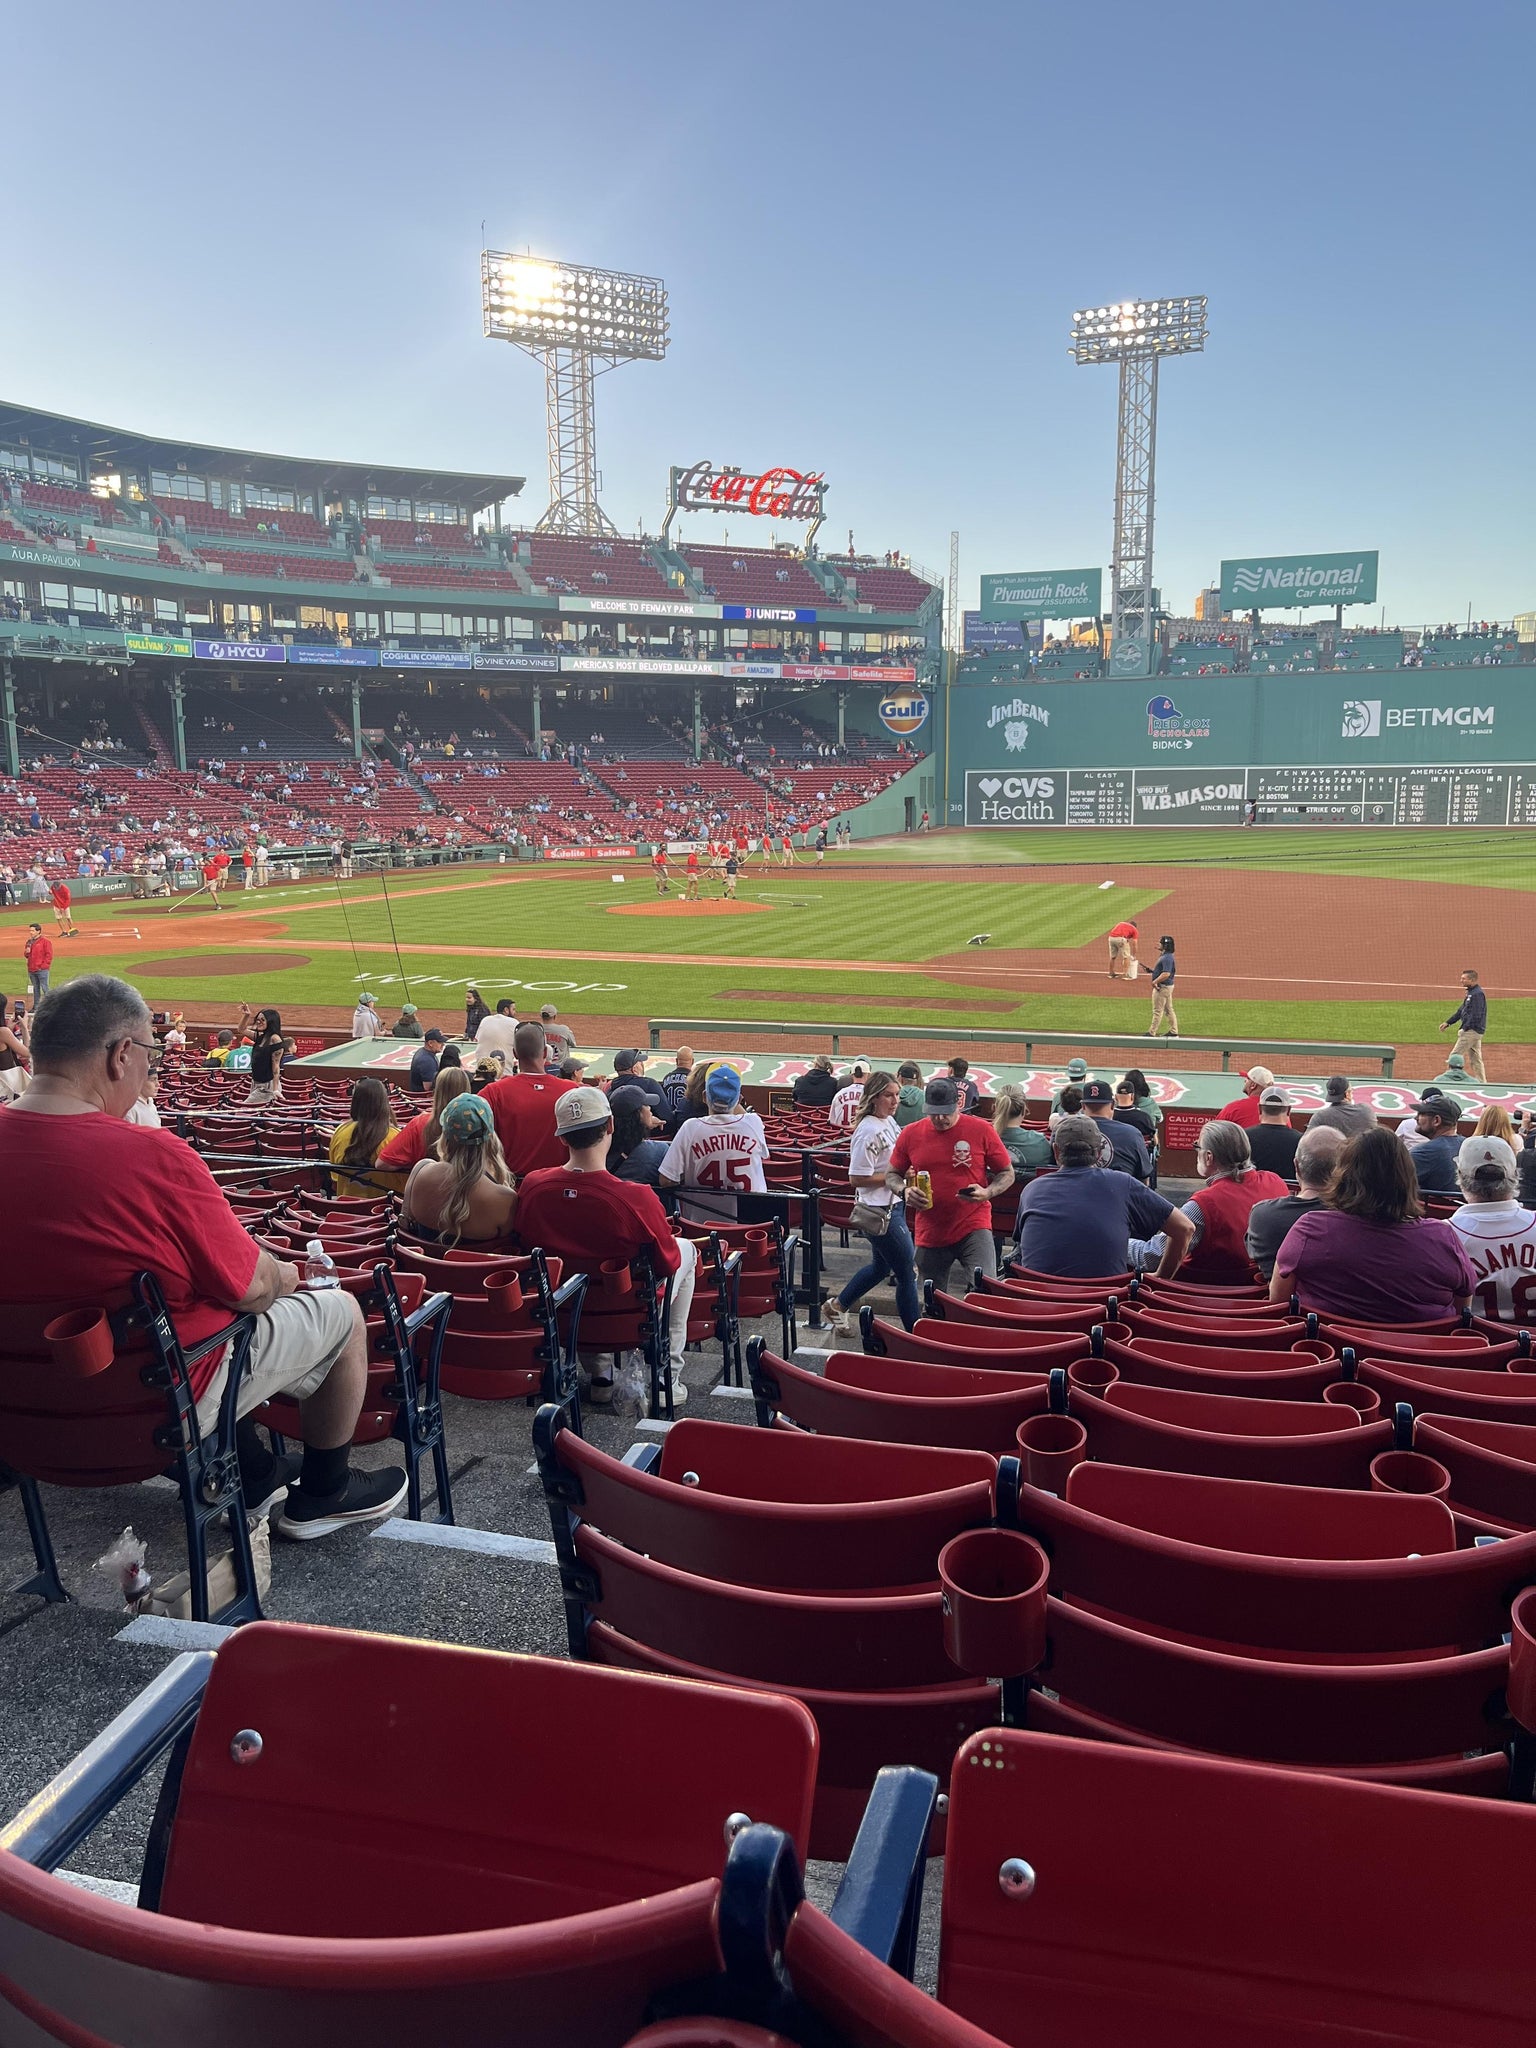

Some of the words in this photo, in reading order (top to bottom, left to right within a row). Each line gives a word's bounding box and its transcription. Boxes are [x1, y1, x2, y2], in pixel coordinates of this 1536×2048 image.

[680, 460, 825, 520] Coca-Cola
[42, 554, 80, 567] PAVILION
[994, 584, 1052, 603] Plymouth
[1055, 582, 1088, 597] Rock
[1296, 589, 1315, 598] Car
[1319, 586, 1357, 597] Rental
[590, 601, 627, 610] WELCOME
[629, 602, 638, 610] TO
[641, 604, 672, 613] FENWAY
[674, 605, 694, 614] PARK
[756, 609, 796, 620] UNITED
[128, 637, 163, 651] SULLIVAN
[174, 644, 189, 653] TIRE
[228, 646, 266, 658] HYCU
[574, 660, 614, 670] AMERICA'S
[617, 662, 636, 670] MOST
[639, 663, 673, 671] BELOVED
[675, 663, 713, 672] BALLPARK
[853, 670, 883, 678] Safelite
[881, 701, 925, 717] Gulf
[987, 704, 1012, 728] JIM
[1012, 699, 1050, 727] BEAM
[1386, 706, 1494, 727] BETMGM
[1154, 720, 1180, 729] RED
[1184, 719, 1210, 728] SOX
[1153, 729, 1210, 737] SCHOLARS
[1152, 741, 1182, 749] BIDMC
[1003, 777, 1054, 798] CVS
[980, 801, 1054, 820] Health
[104, 883, 126, 891] TICKET
[351, 973, 628, 992] WHOOP
[233, 1054, 251, 1069] 19
[1090, 1086, 1100, 1096] B
[569, 1101, 583, 1120] B
[691, 1134, 757, 1159] MARTINEZ
[697, 1158, 752, 1192] 45
[1470, 1243, 1536, 1279] DAMO
[1475, 1275, 1536, 1320] 18
[158, 1316, 171, 1335] FF
